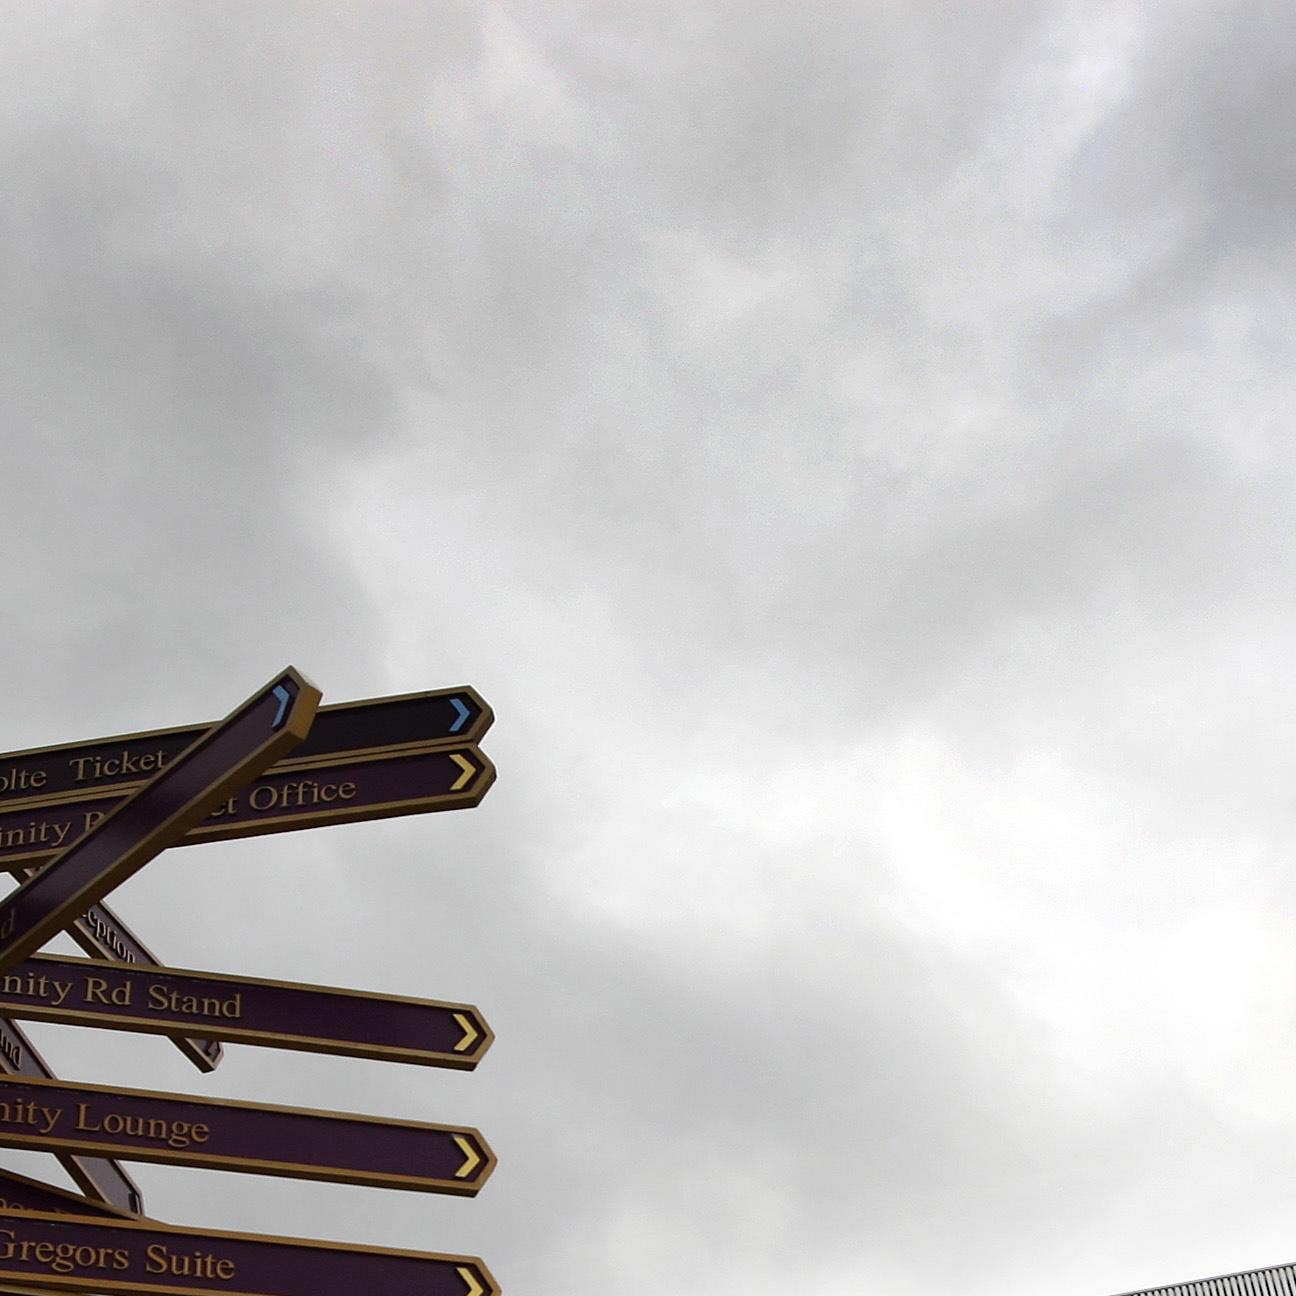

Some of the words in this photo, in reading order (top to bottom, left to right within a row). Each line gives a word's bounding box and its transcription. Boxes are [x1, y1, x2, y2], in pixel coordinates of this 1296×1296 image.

[69, 749, 167, 782] Ticket
[249, 780, 357, 811] Office
[84, 976, 132, 1006] Rd
[148, 984, 242, 1019] Stand
[75, 1103, 211, 1146] Lounge
[145, 1244, 236, 1281] Suite
